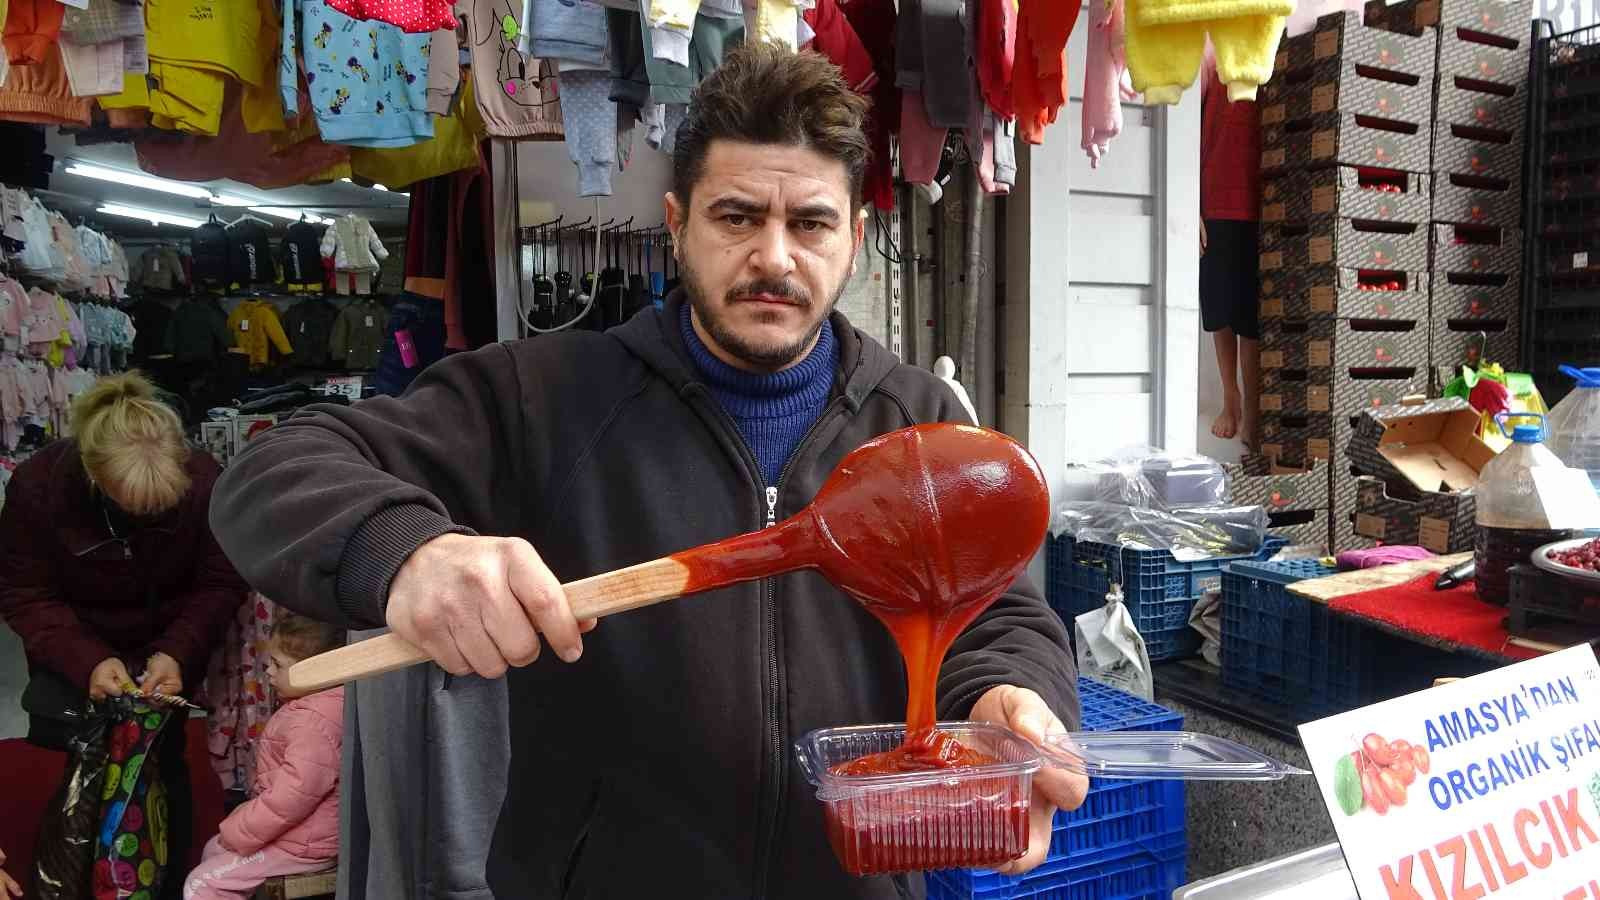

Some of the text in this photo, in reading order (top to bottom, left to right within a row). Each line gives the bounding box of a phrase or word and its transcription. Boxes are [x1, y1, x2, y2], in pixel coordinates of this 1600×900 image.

[1424, 676, 1579, 753] AMASYA'DAN
[1428, 738, 1551, 811] ORGANİK
[1378, 787, 1600, 900] KIZILCIK
